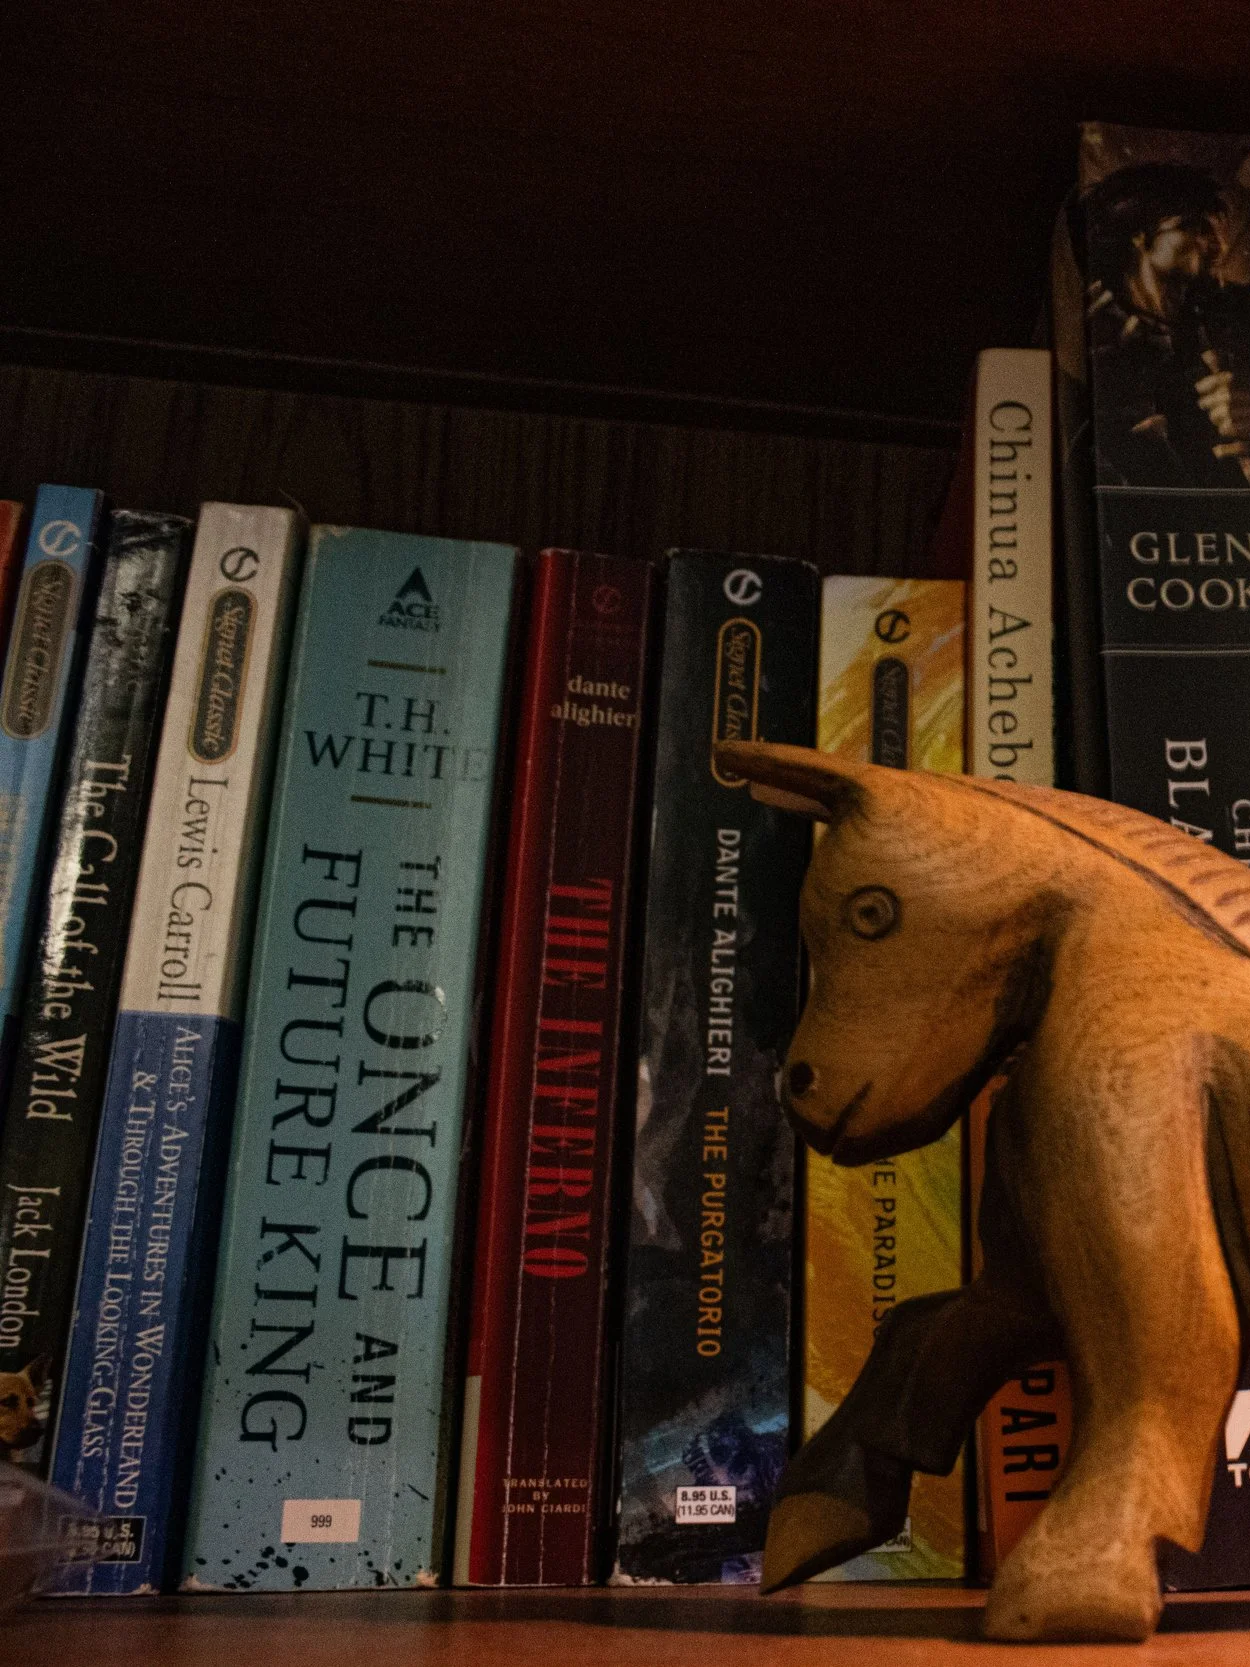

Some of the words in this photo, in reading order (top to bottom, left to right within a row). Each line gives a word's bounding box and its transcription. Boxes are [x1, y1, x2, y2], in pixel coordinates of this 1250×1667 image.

[988, 401, 1034, 582] Chinua
[377, 614, 441, 633] FANTASY
[388, 601, 438, 619] ACE
[567, 674, 631, 701] dante
[82, 754, 132, 818] The
[304, 730, 489, 782] WHITE
[177, 775, 229, 869] Lewis
[74, 829, 119, 905] Call
[391, 856, 442, 949] THE
[712, 828, 741, 918] DANTE
[63, 916, 99, 955] of
[158, 881, 214, 1003] Carroll
[544, 877, 613, 990] THE
[42, 964, 95, 1021] the
[266, 843, 363, 1187] FUTURE
[706, 928, 737, 1077] ALIGHIERI
[25, 1033, 88, 1122] Wild
[132, 1070, 159, 1092] &
[167, 1026, 202, 1113] ALICE'S
[115, 1101, 156, 1213] THROUGH
[338, 980, 448, 1301] ONCE
[522, 1018, 604, 1280] INFERNO
[702, 1105, 730, 1162] THE
[6, 1183, 62, 1238] Jack
[108, 1222, 134, 1265] THE
[142, 1124, 190, 1283] ADVENTURES
[0, 1247, 52, 1349] London
[138, 1288, 164, 1318] IN
[696, 1172, 727, 1358] PURGATORIO
[872, 1197, 896, 1332] PARADIS
[240, 1216, 321, 1452] KING
[114, 1323, 166, 1509] WONDERLAND
[347, 1332, 399, 1446] AND
[311, 1514, 333, 1528] 999
[501, 1504, 535, 1514] JOHN
[541, 1503, 587, 1514] CIARDI
[503, 1478, 588, 1489] TRANSLATED
[532, 1491, 550, 1501] BY
[678, 1505, 710, 1517] (11.95
[711, 1504, 735, 1517] CAN)
[681, 1491, 706, 1501] 8.95
[710, 1490, 732, 1501] U.S.
